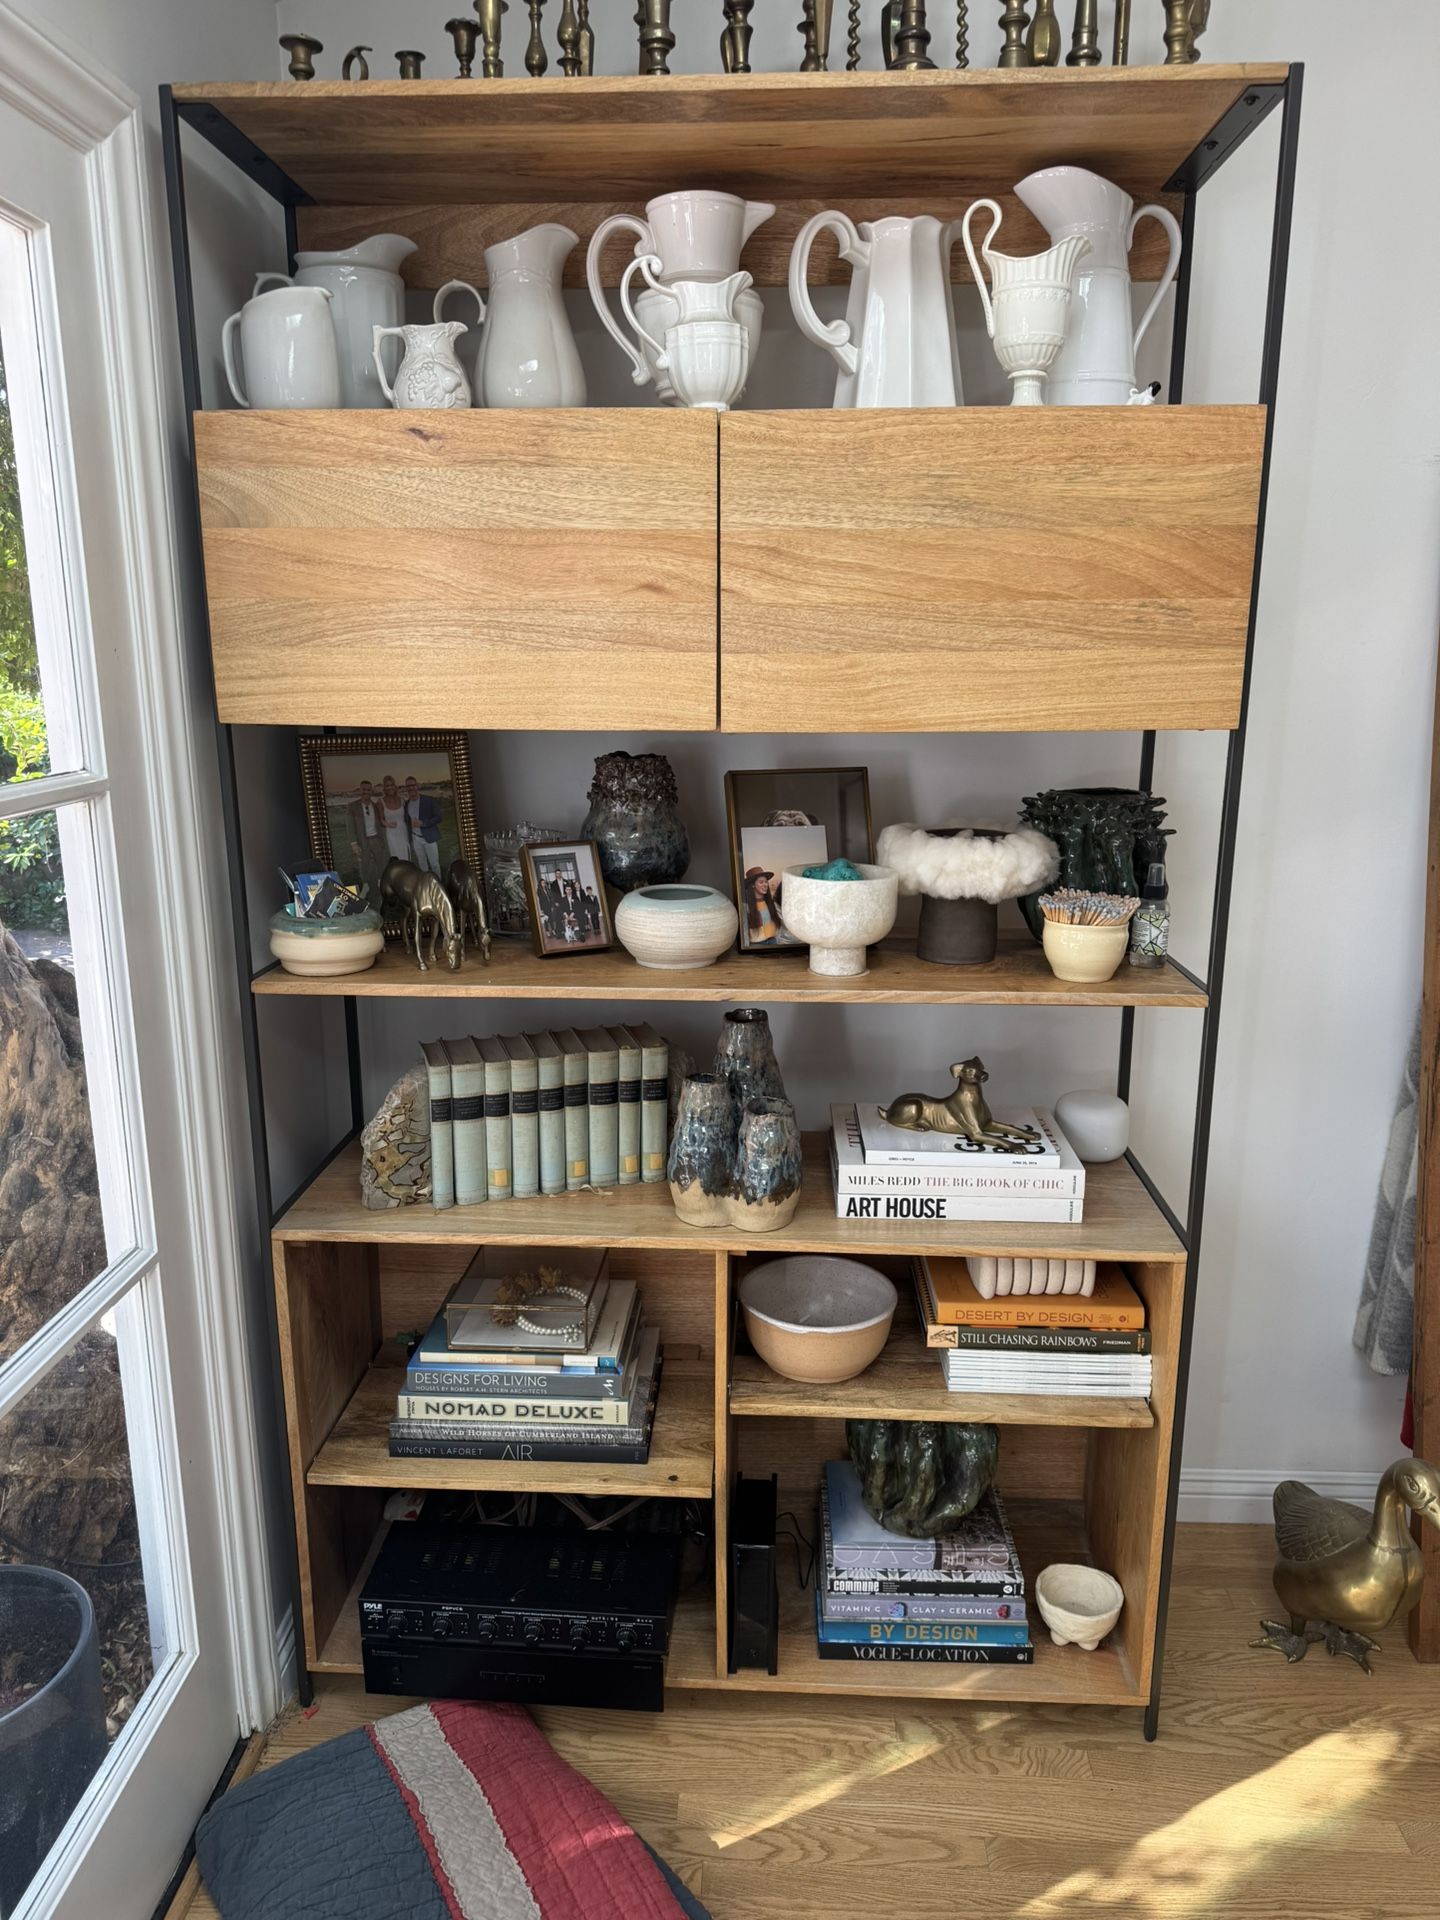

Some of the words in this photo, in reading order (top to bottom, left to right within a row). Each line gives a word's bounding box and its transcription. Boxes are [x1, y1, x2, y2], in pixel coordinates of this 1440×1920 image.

[848, 1175, 885, 1186] MILES
[887, 1176, 921, 1186] REDD
[924, 1177, 950, 1187] THE
[953, 1177, 973, 1187] BIG
[976, 1178, 1010, 1189] BOOK
[1013, 1179, 1031, 1189] OF
[1033, 1179, 1064, 1190] CHIC
[846, 1197, 881, 1217] ART
[886, 1197, 947, 1219] HOUSE
[955, 1310, 1012, 1321] DESERT
[1016, 1311, 1034, 1322] BY
[1038, 1312, 1094, 1323] DESIGN
[960, 1332, 988, 1344] STILL
[989, 1333, 1039, 1345] CHASING
[1041, 1334, 1098, 1347] RAINBOWS
[415, 1372, 470, 1386] DESIGNS
[474, 1374, 500, 1386] FOR
[503, 1375, 548, 1388] LIVING
[489, 1387, 508, 1395] STERN
[510, 1388, 548, 1396] ARCHITECTS
[425, 1401, 507, 1417] NOMAD
[515, 1404, 604, 1420] DELUXE
[441, 1428, 465, 1436] WILD
[467, 1429, 502, 1438] HORSES
[519, 1431, 579, 1440] CUMBERLAND
[397, 1446, 437, 1455] VINCENT
[440, 1447, 484, 1456] LAFORET
[501, 1444, 533, 1460] AIR
[833, 1542, 1010, 1567] OASIS
[363, 1602, 383, 1610] PYLE
[831, 1605, 871, 1613] VITAMIN
[912, 1607, 937, 1615] CLAY
[949, 1607, 993, 1615] CERAMIC
[869, 1623, 896, 1639] BY
[905, 1625, 978, 1641] DESIGN
